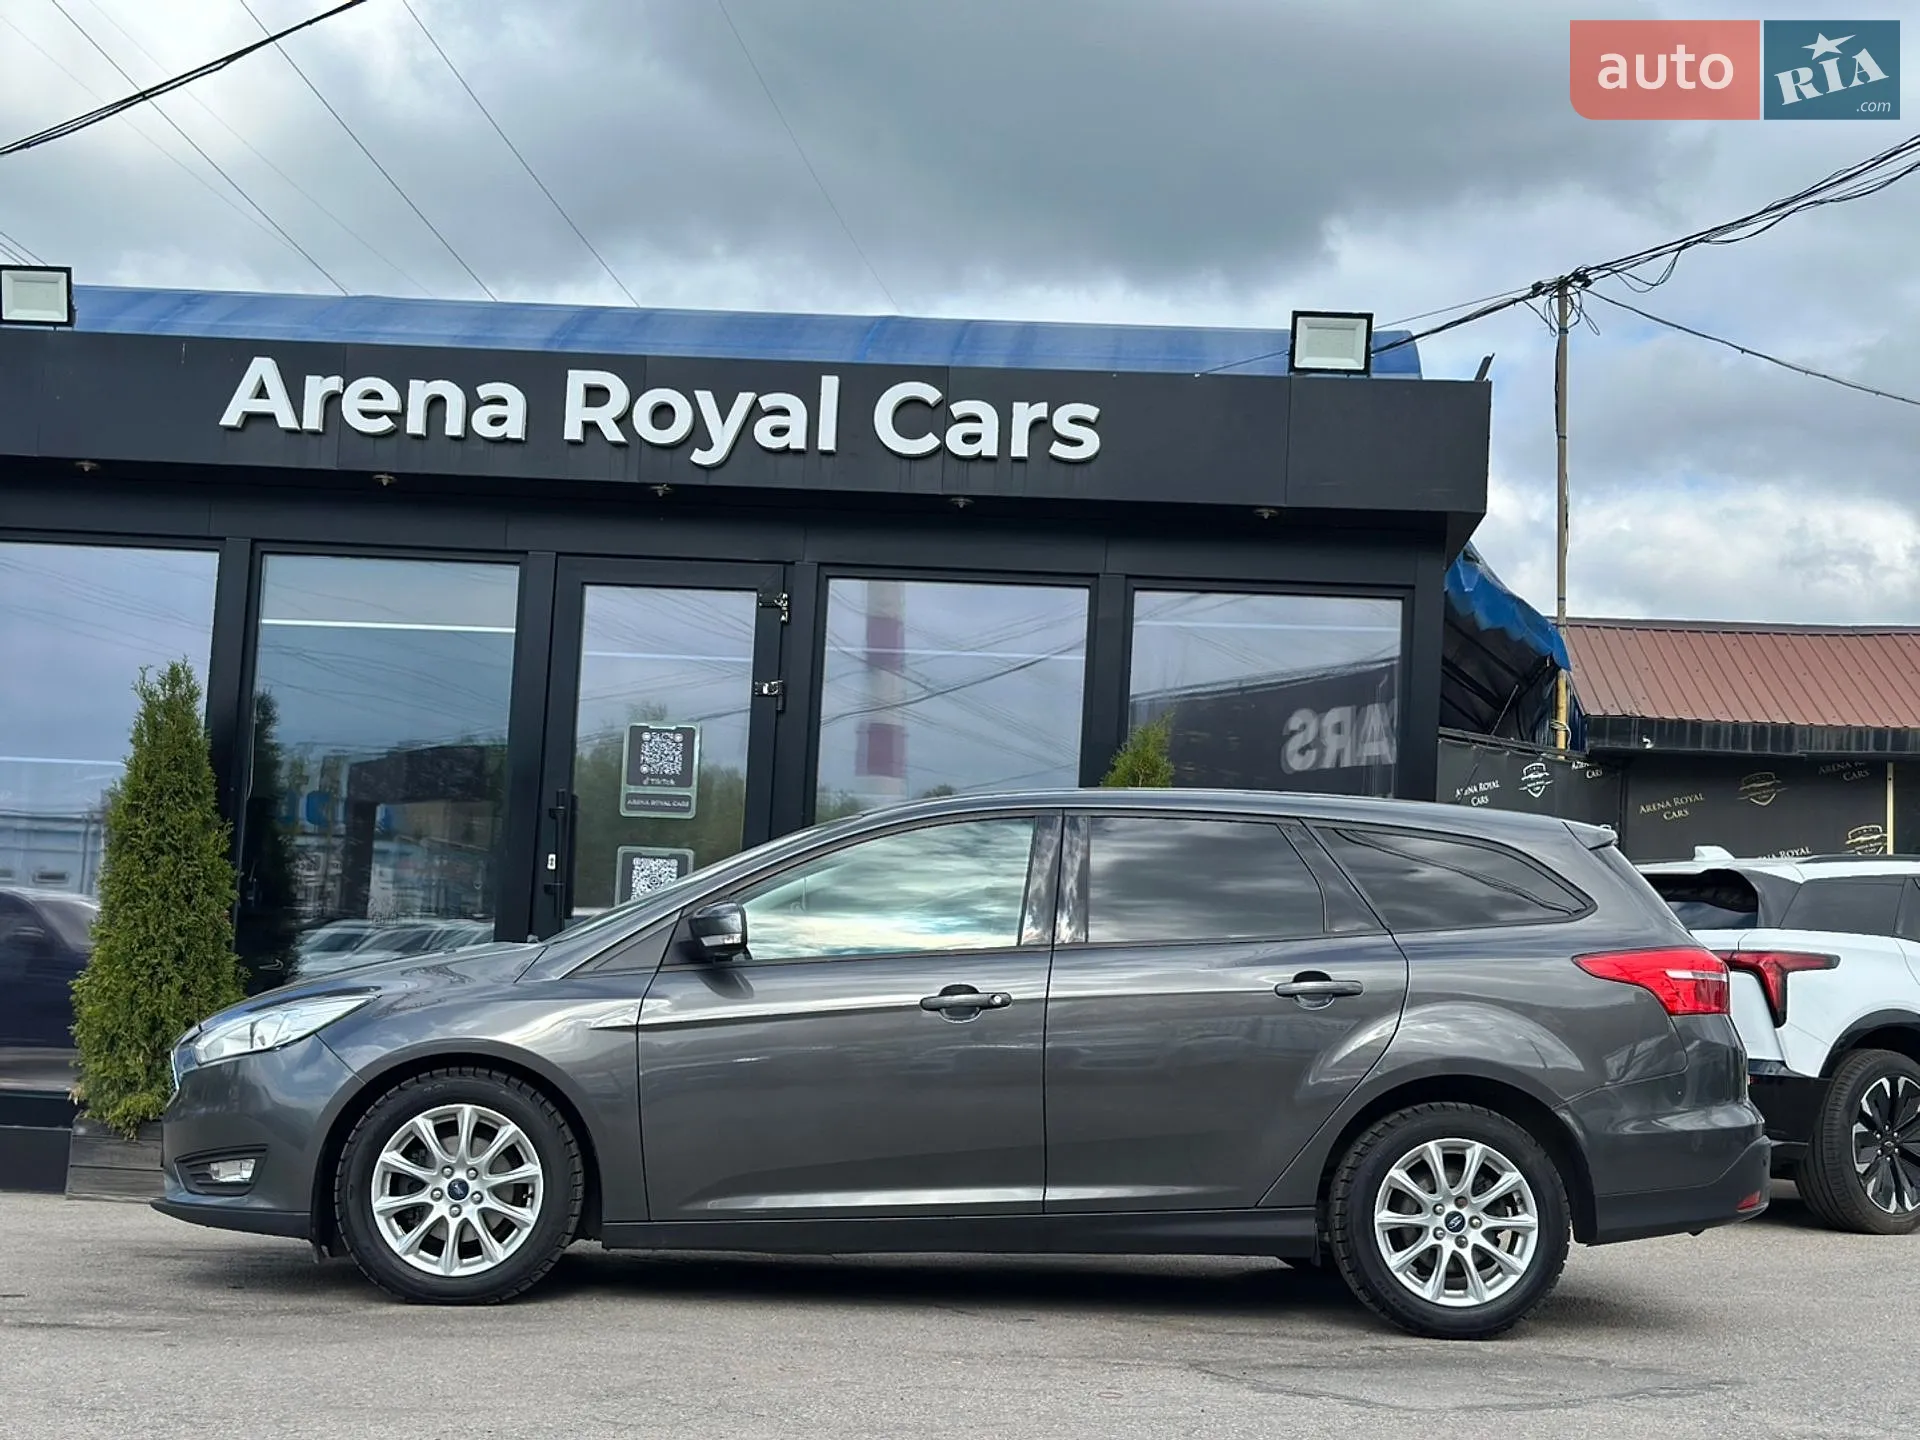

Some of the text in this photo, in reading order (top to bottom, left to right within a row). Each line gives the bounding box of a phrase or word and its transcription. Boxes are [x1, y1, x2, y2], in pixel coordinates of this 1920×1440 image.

[218, 356, 1101, 468] Arena Royal Cars
[1639, 793, 1705, 815] ARENA ROYAL
[1662, 808, 1690, 821] CARS
